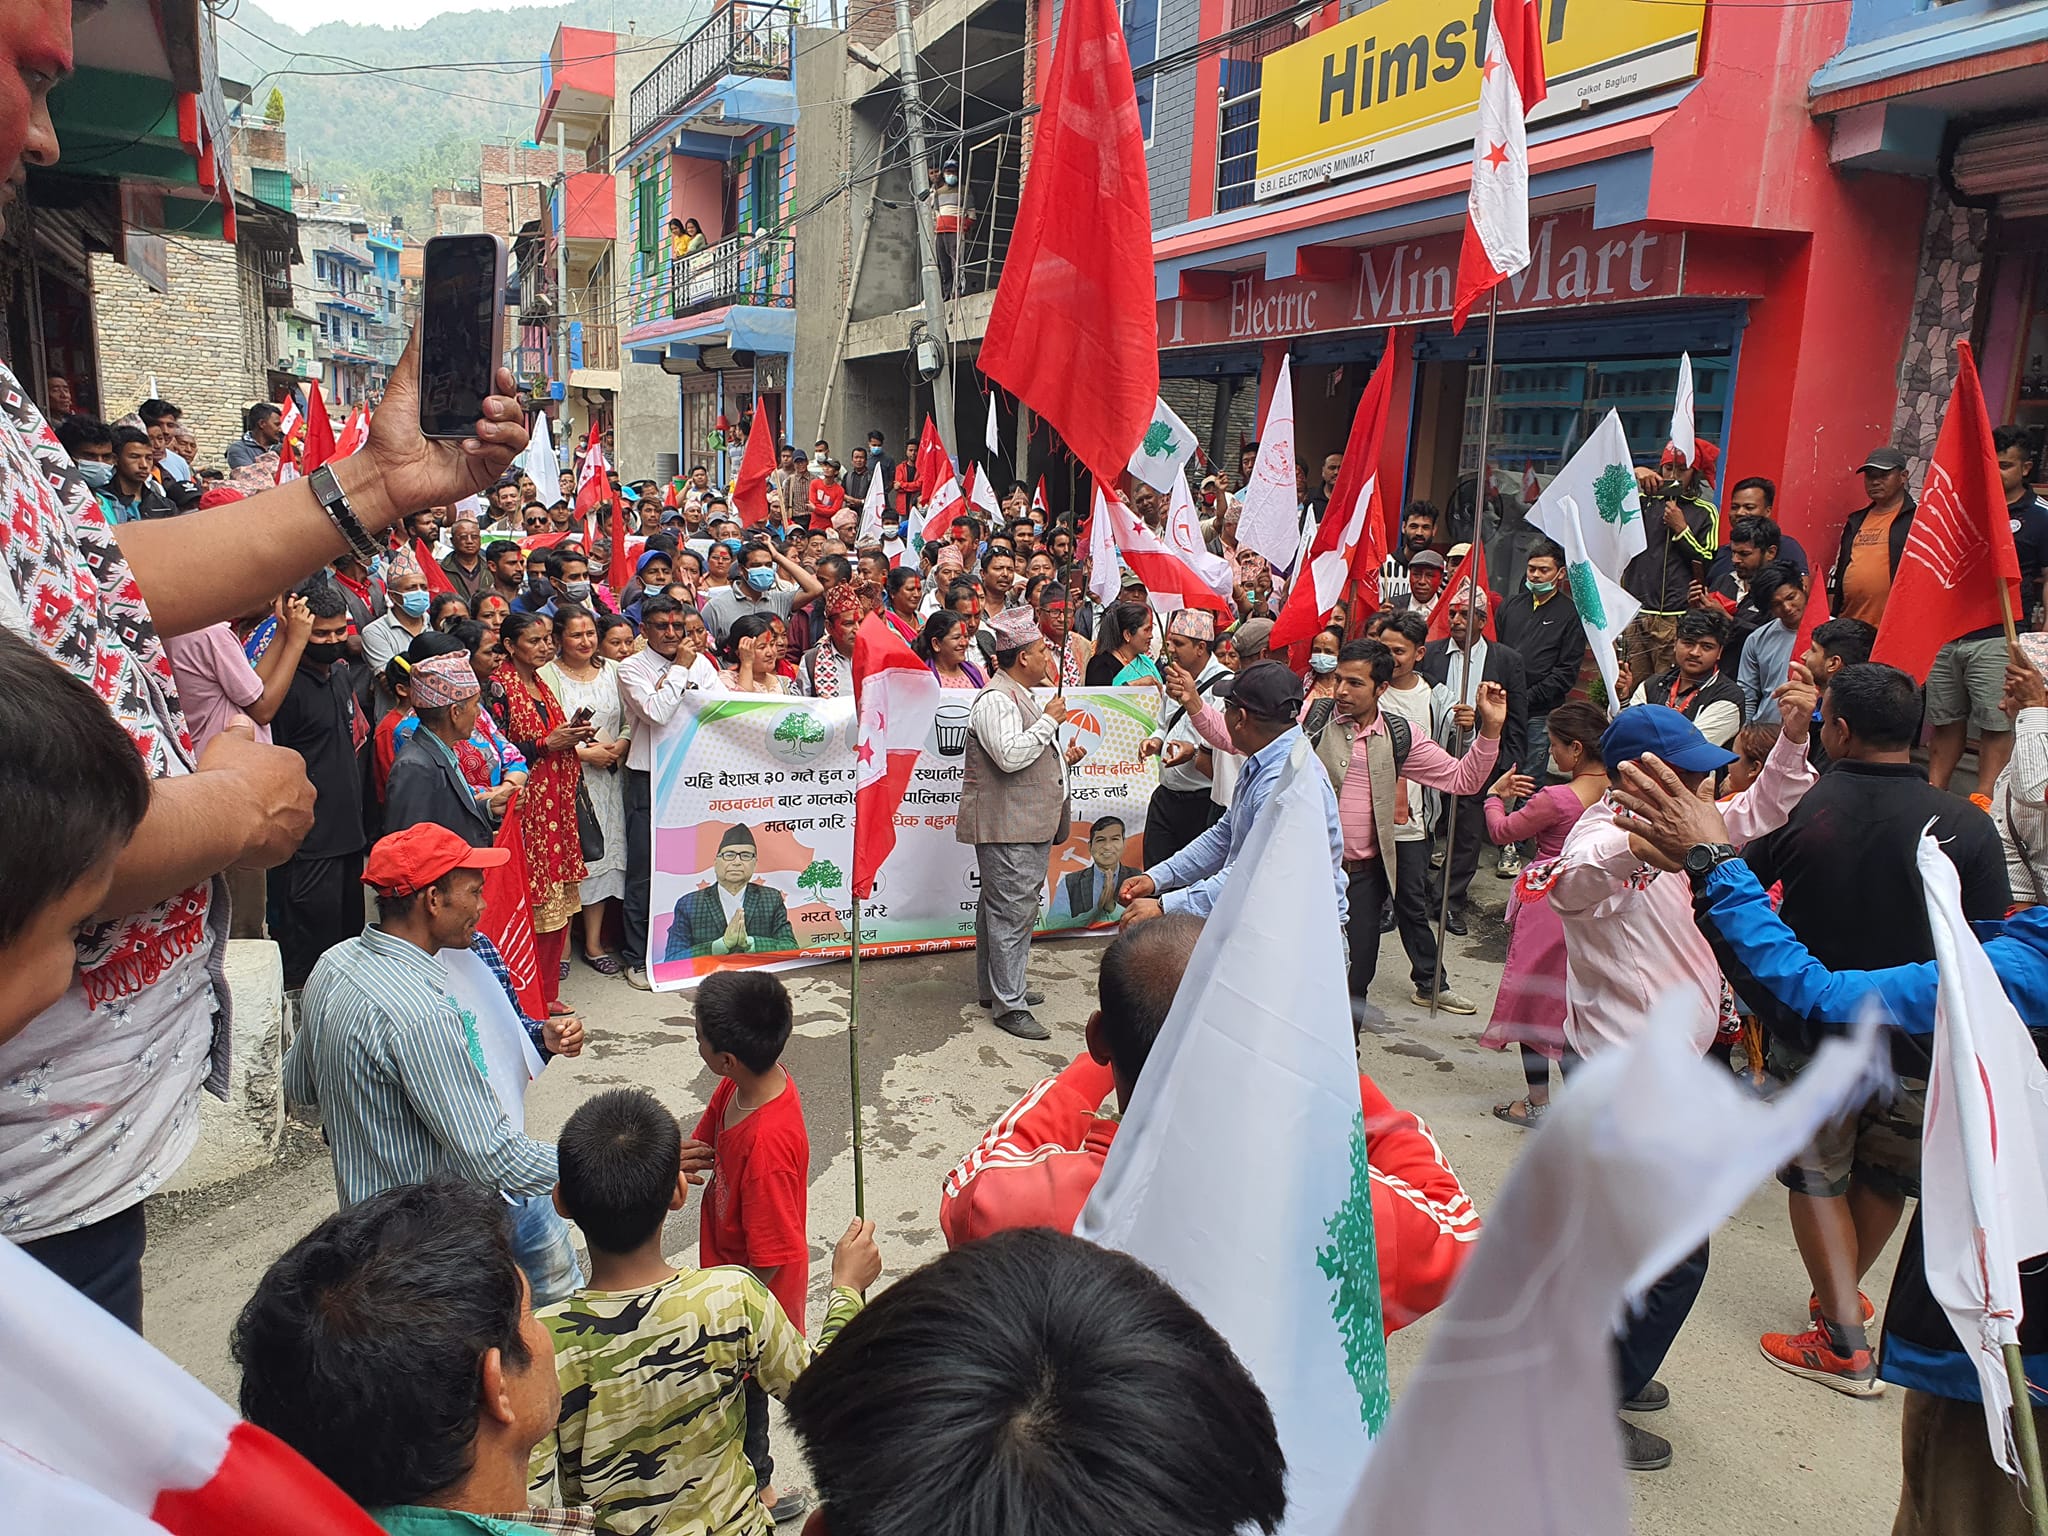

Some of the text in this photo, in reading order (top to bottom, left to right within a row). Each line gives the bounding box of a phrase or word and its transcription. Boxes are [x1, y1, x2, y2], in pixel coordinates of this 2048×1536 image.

[1319, 0, 1567, 124] Himstr
[1577, 72, 1638, 97] Galkot Baglung
[1279, 162, 1332, 188] ELECTRONICS
[1333, 149, 1376, 172] MINIMART
[1229, 273, 1318, 337] Electric
[1353, 245, 1454, 321] Min
[1487, 218, 1658, 305] Mart
[684, 772, 715, 789] यहि
[719, 770, 760, 787] वैशाख
[764, 771, 785, 785] ३०
[791, 768, 817, 783] गते
[709, 796, 775, 812] गठबन्धन
[778, 795, 803, 808] बाट
[807, 790, 857, 806] गलको
[764, 817, 816, 833] मतदान
[801, 910, 833, 923] भरत
